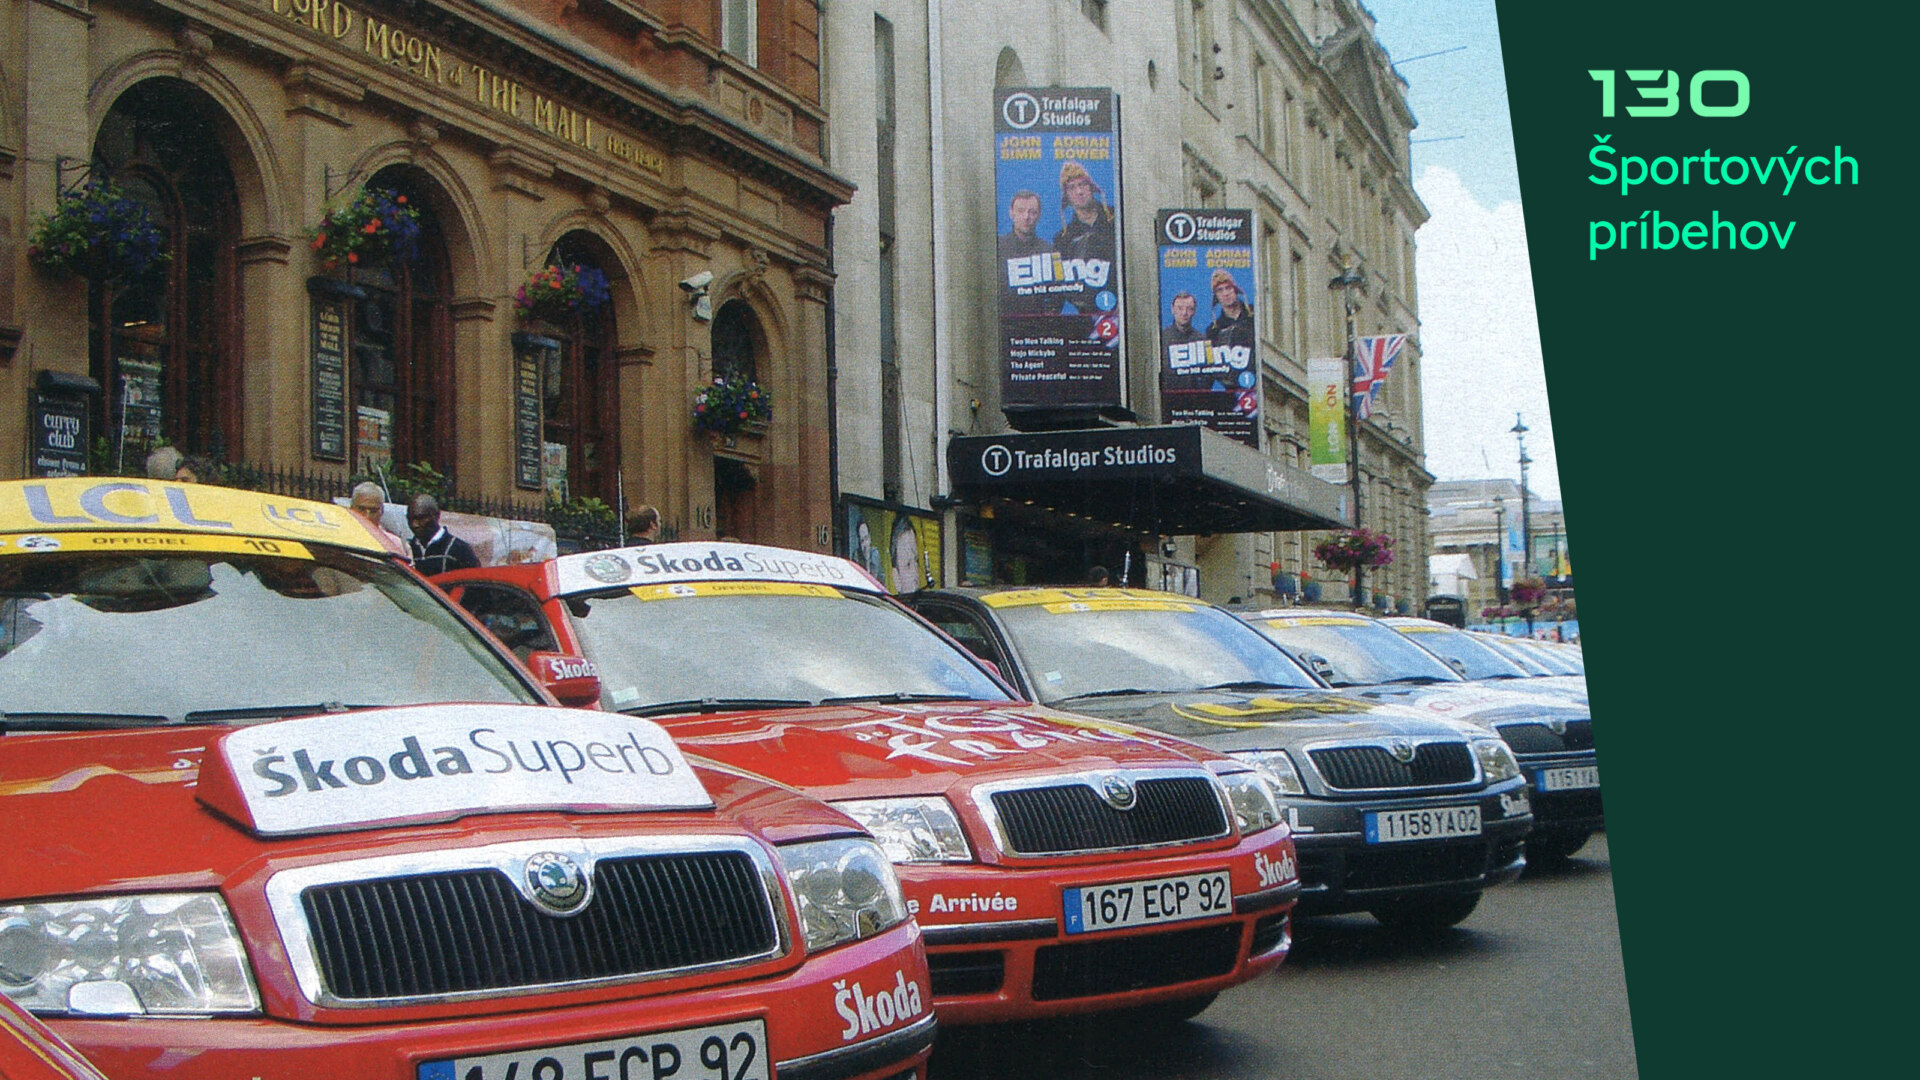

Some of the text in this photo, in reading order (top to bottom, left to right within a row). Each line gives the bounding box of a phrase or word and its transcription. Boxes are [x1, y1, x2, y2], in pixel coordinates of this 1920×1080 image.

[365, 17, 441, 83] MOON
[472, 64, 522, 118] THE
[1041, 96, 1101, 113] Trafalgar
[1042, 111, 1092, 126] Studios
[1001, 136, 1042, 148] JOHN
[1053, 136, 1110, 148] ADRIAN
[1054, 148, 1110, 159] BOWER
[1196, 216, 1244, 230] Trafalgar
[1196, 228, 1237, 241] Studios
[1006, 252, 1111, 289] Elling
[1168, 340, 1252, 370] Elling
[43, 413, 80, 435] curry
[48, 429, 75, 449] club
[1014, 448, 1101, 472] Trafalgar
[1103, 444, 1177, 466] Studios
[22, 482, 234, 530] LCL
[267, 504, 341, 528] LCL
[92, 537, 282, 554] OFFICIEL 10
[816, 525, 829, 545] 16
[1254, 848, 1298, 888] Škoda
[929, 891, 1018, 914] Arrivée
[1085, 876, 1227, 926] 167 ECP 92
[832, 968, 923, 1041] Škoda
